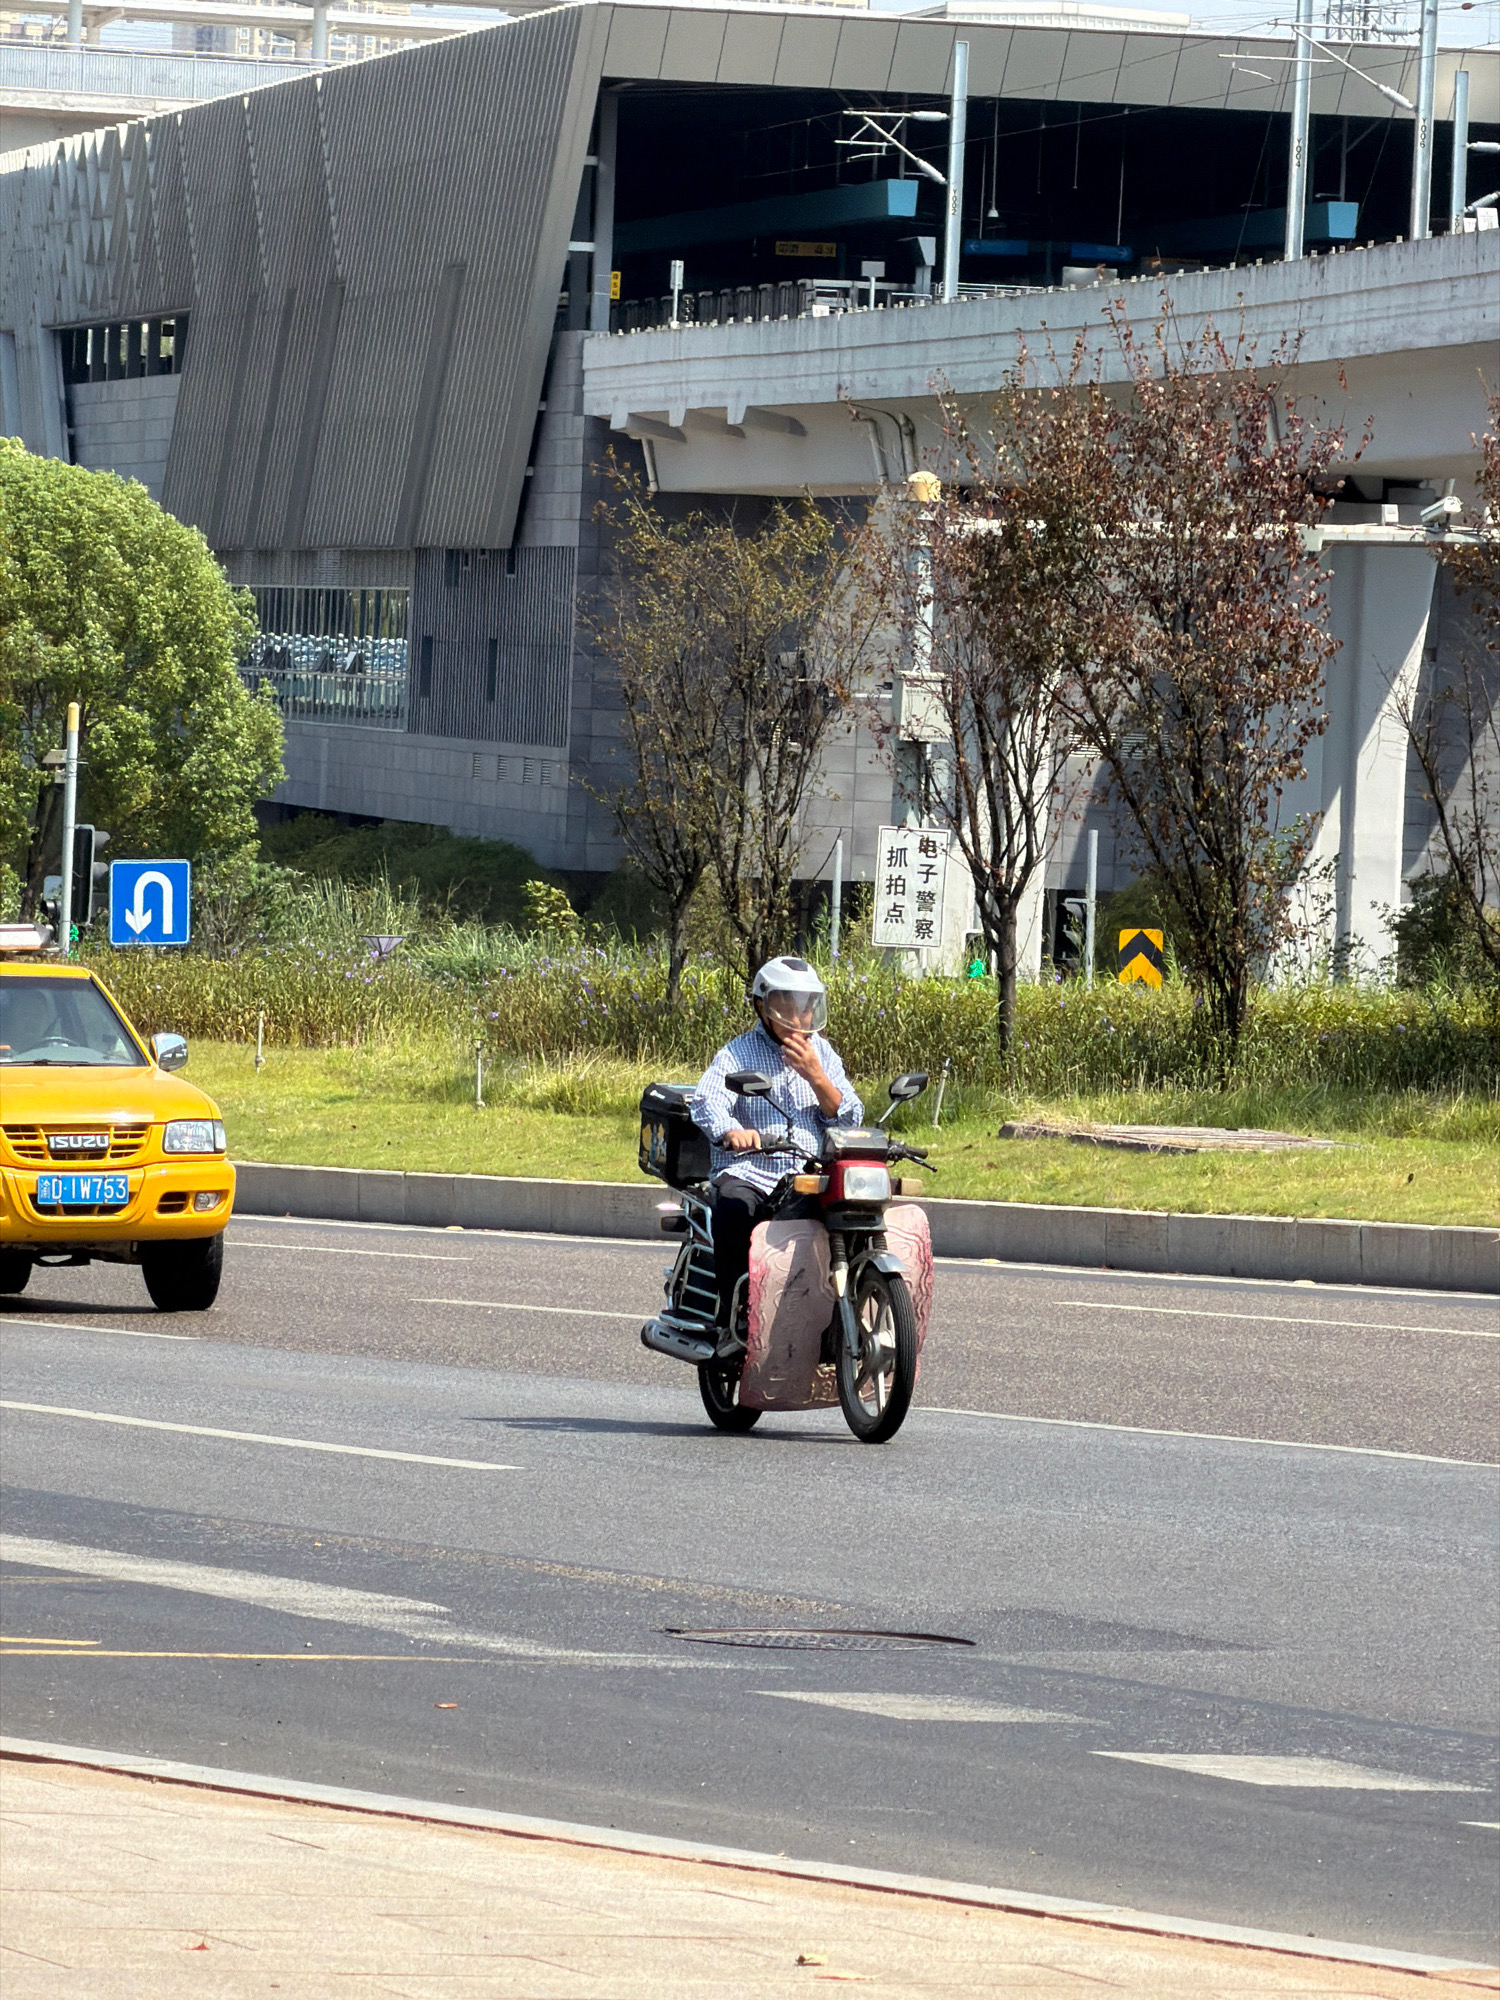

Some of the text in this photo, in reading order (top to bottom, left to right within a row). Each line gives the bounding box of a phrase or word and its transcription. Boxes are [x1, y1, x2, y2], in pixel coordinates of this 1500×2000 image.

[884, 846, 908, 924] 抓拍点
[915, 836, 938, 940] 电子警察
[49, 1135, 109, 1149] ISUZU
